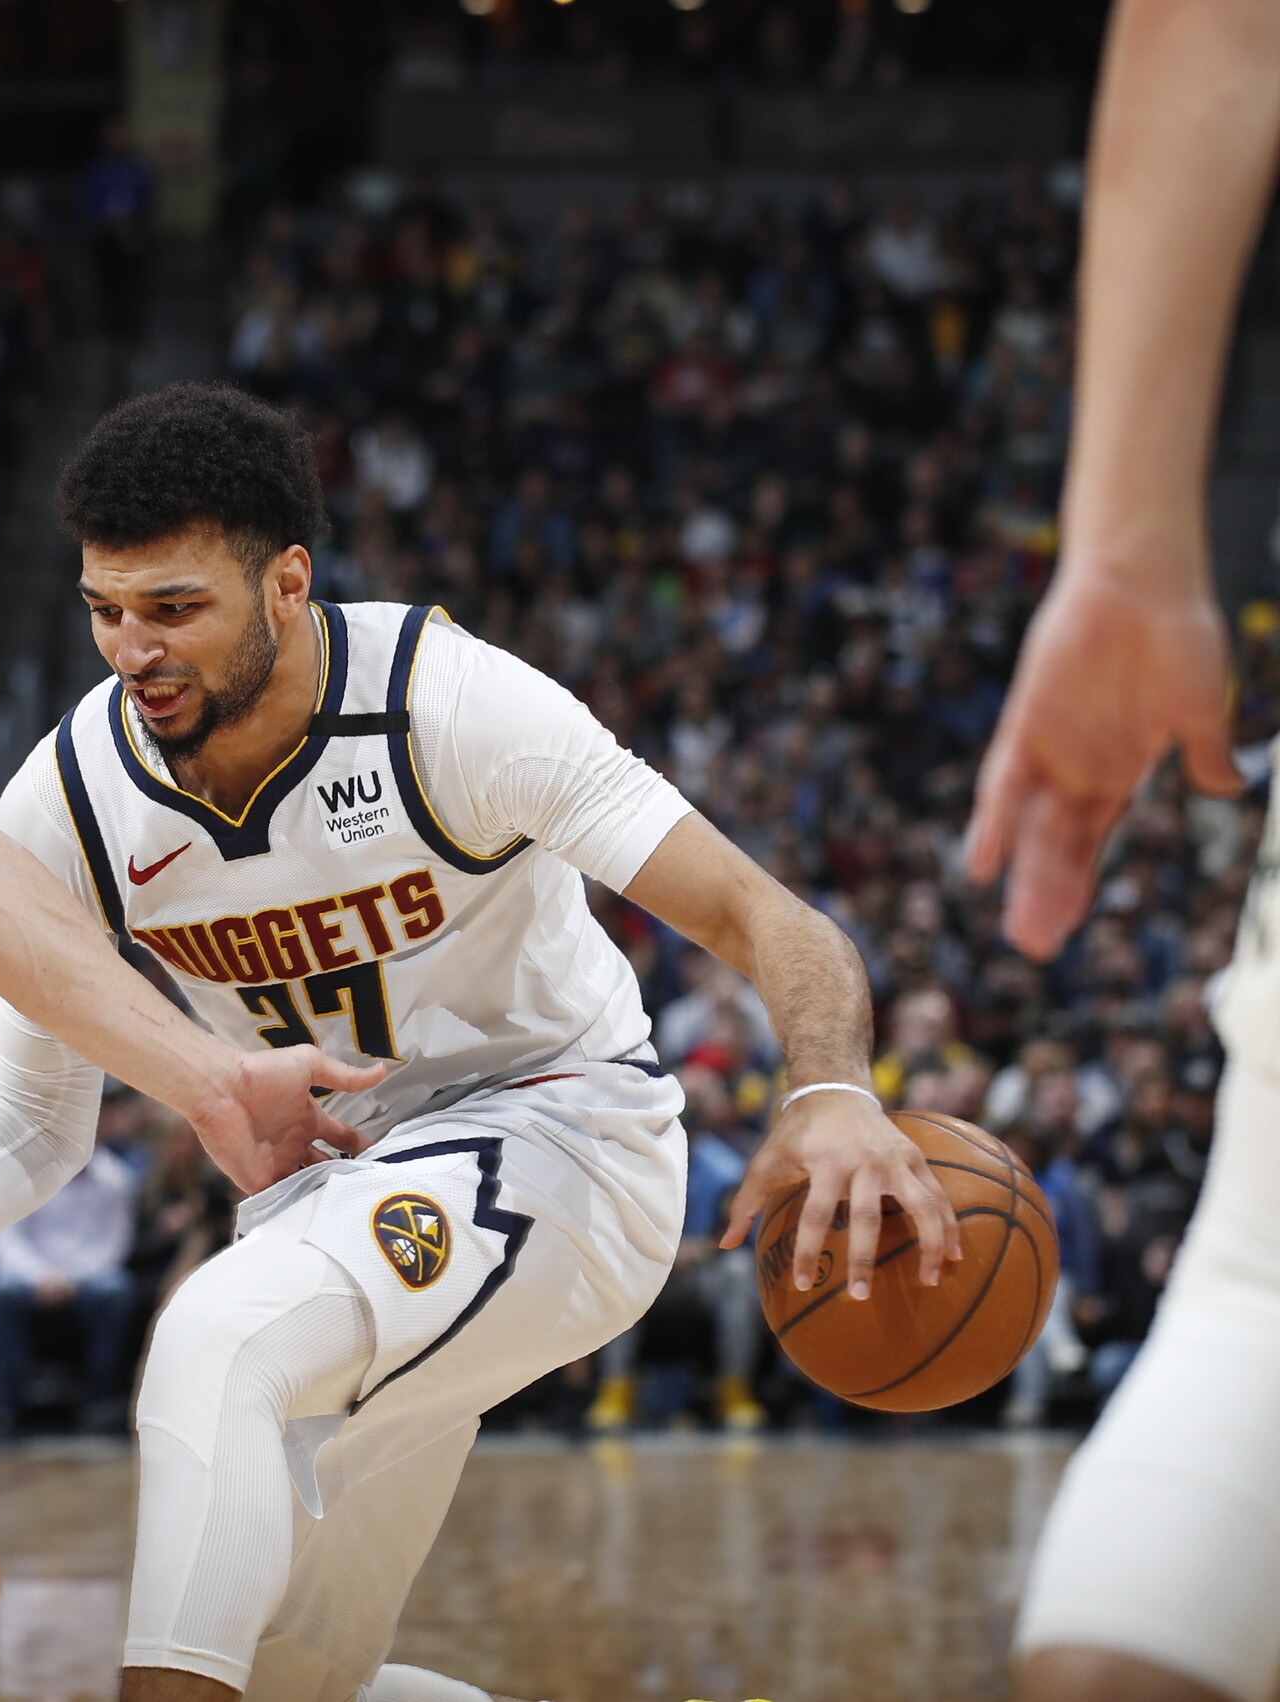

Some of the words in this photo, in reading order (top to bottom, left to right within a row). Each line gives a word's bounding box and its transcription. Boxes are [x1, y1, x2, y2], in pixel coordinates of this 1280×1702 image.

[317, 770, 382, 814] WU
[326, 807, 390, 832] Western
[341, 824, 385, 844] Union
[128, 865, 447, 984] NUGGETS
